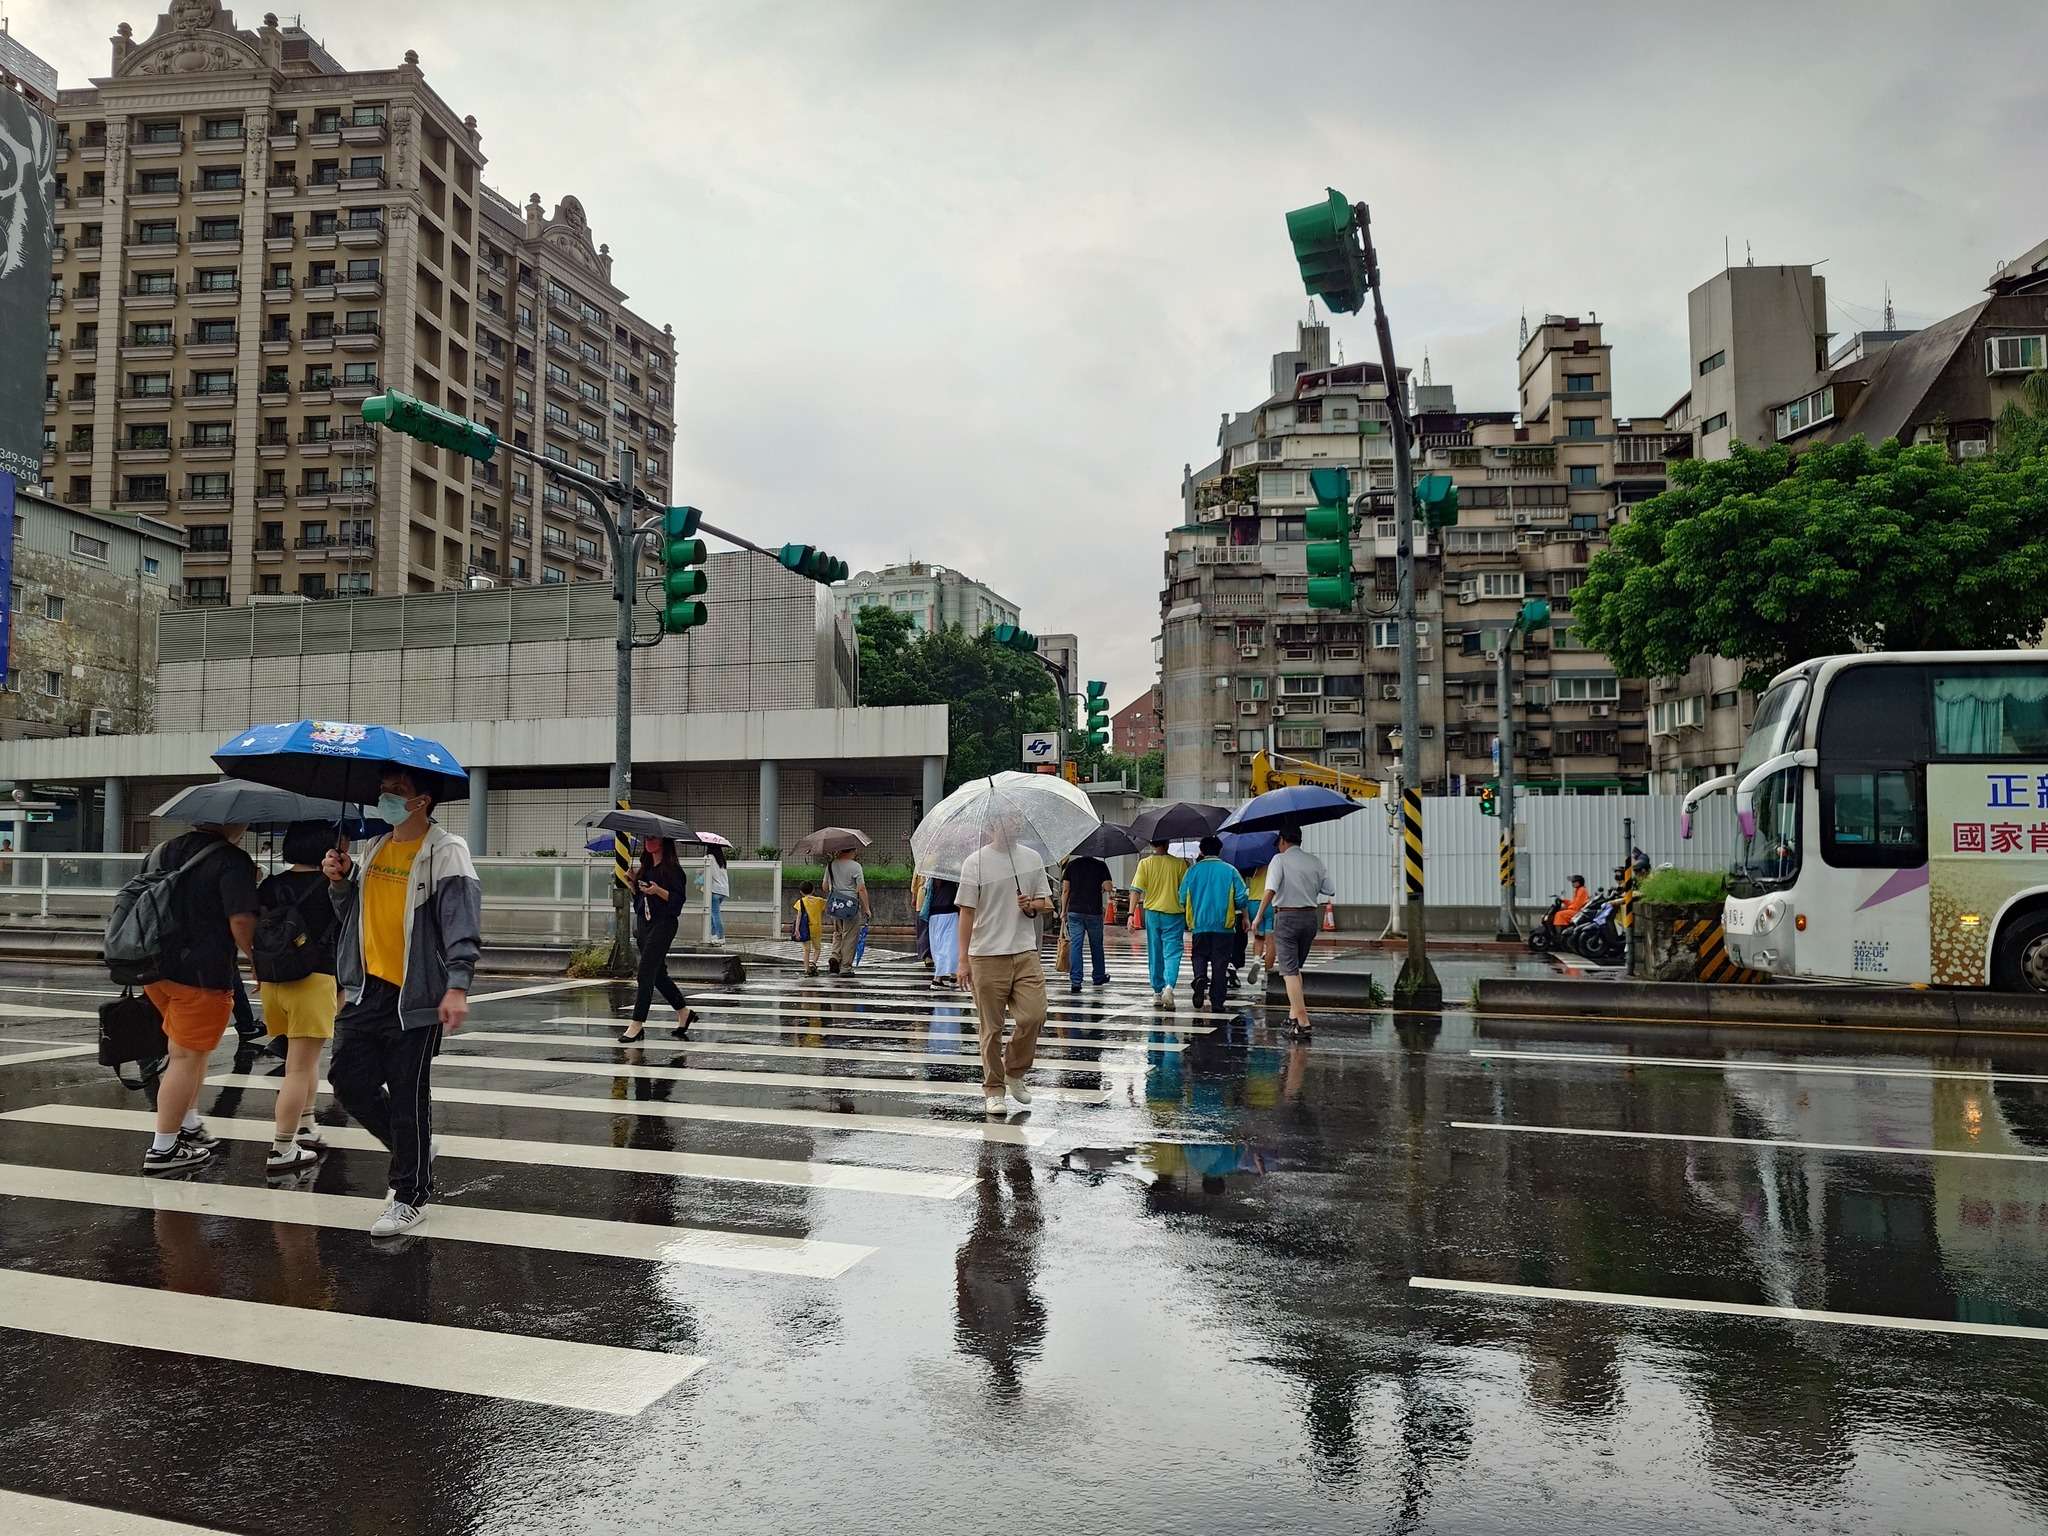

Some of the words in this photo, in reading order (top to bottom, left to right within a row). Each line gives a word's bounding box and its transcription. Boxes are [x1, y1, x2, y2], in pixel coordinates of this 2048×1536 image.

[1986, 773, 2048, 809] 正
[1953, 822, 2048, 854] 國家肯
